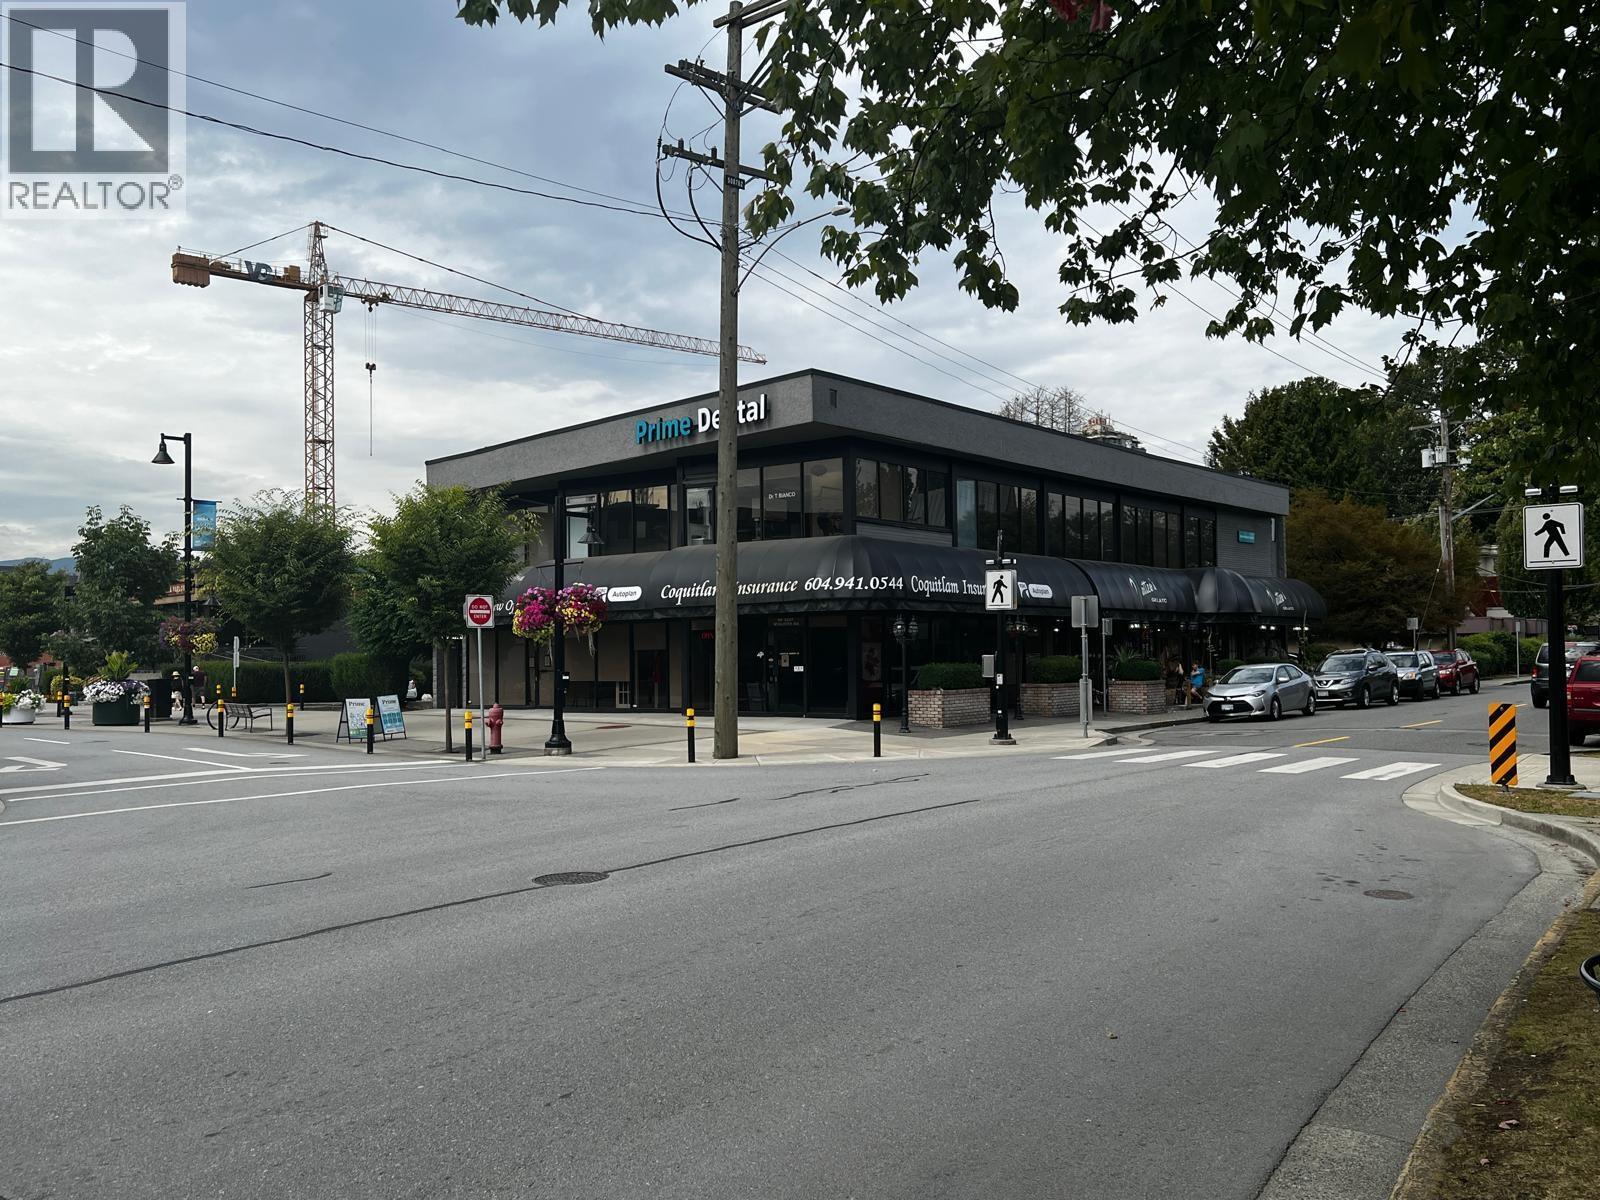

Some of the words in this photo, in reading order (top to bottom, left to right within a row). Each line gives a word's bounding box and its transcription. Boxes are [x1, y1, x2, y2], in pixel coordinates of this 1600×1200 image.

[636, 416, 692, 444] Prime
[698, 393, 767, 433] Detal
[736, 577, 798, 596] nsurance
[804, 576, 904, 592] 604.941.0544
[910, 575, 960, 598] Coquitlam
[962, 578, 986, 596] Insur
